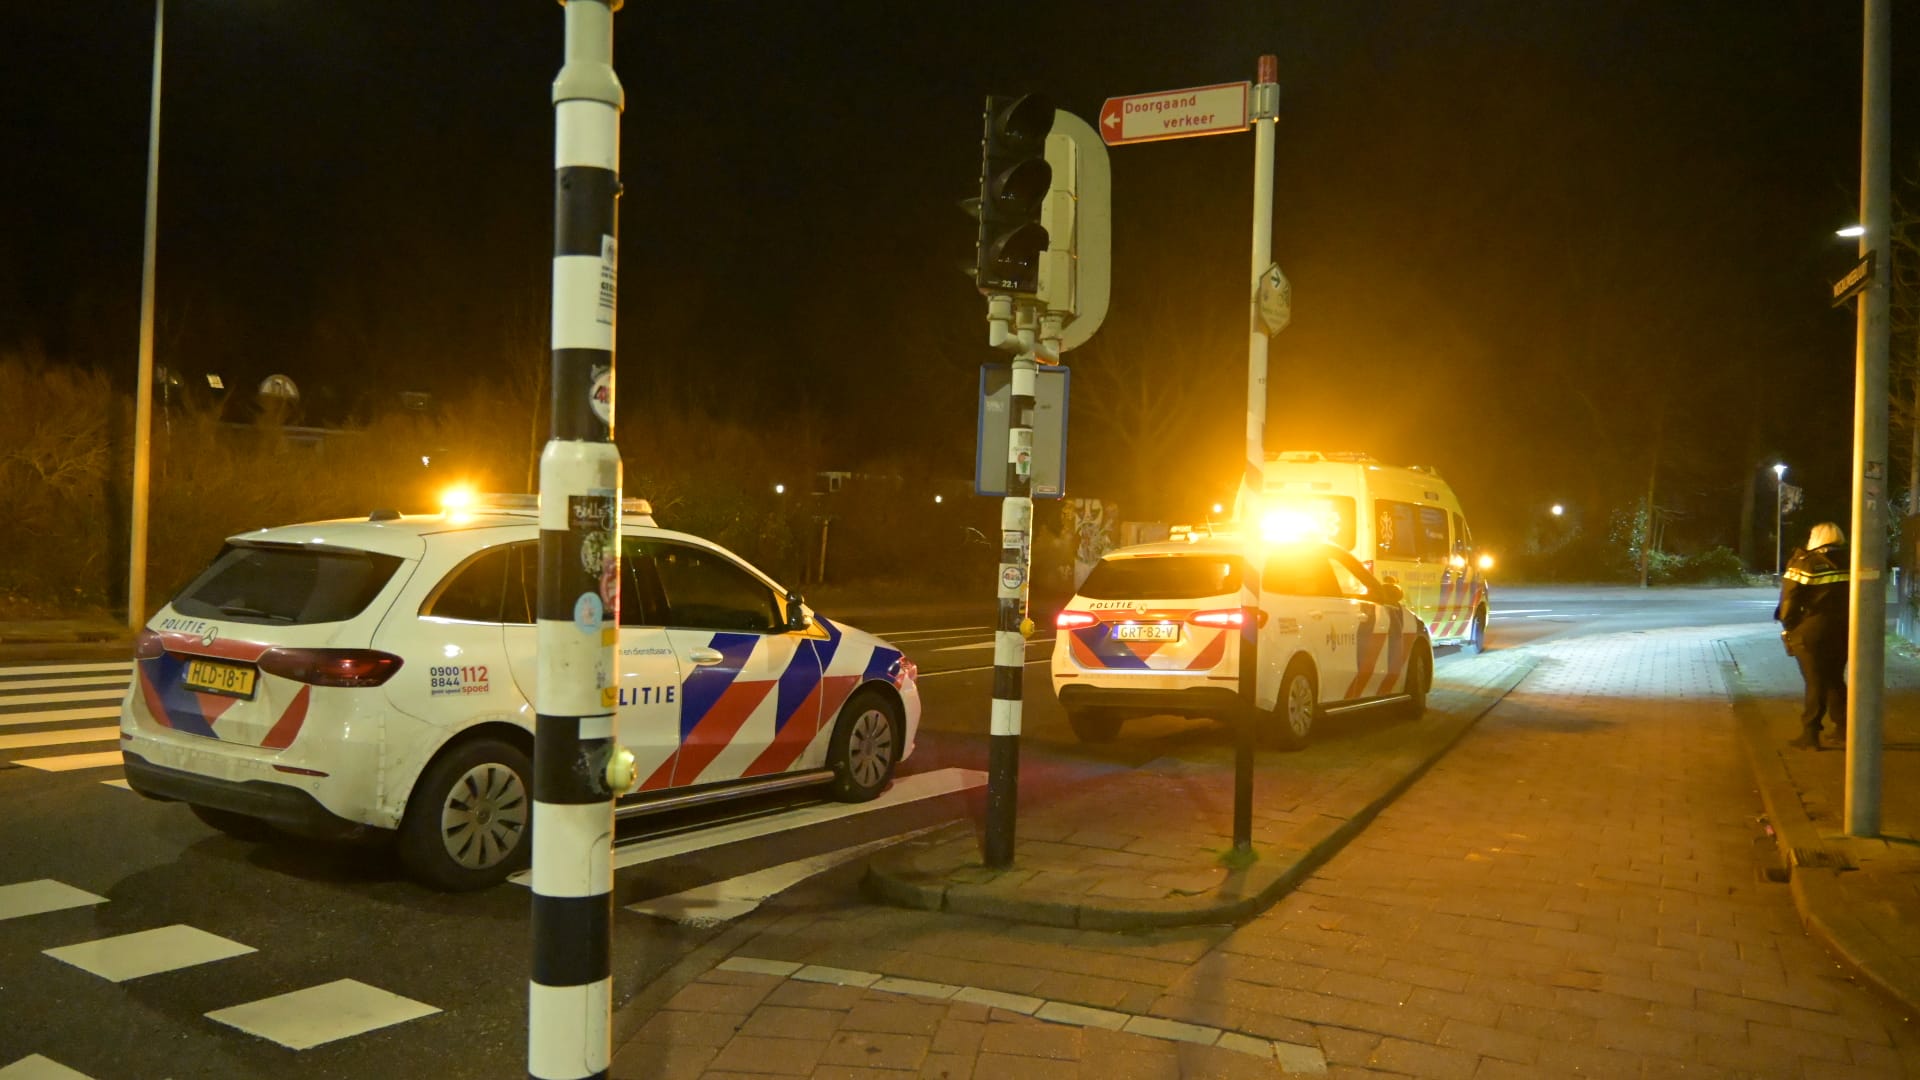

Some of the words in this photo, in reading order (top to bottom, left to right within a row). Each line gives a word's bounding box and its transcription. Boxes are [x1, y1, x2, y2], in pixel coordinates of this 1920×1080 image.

[1125, 95, 1197, 114] Doorgaand
[1163, 113, 1216, 129] verkeer
[1002, 279, 1018, 289] 22.1
[159, 618, 206, 634] POLITIE
[1120, 626, 1174, 638] GRT-82-V
[191, 662, 249, 690] HLD-18-T
[430, 666, 460, 677] 0900
[461, 665, 488, 682] 112
[431, 677, 460, 688] 8844
[462, 683, 489, 695] spoed
[619, 685, 676, 706] LITIE
